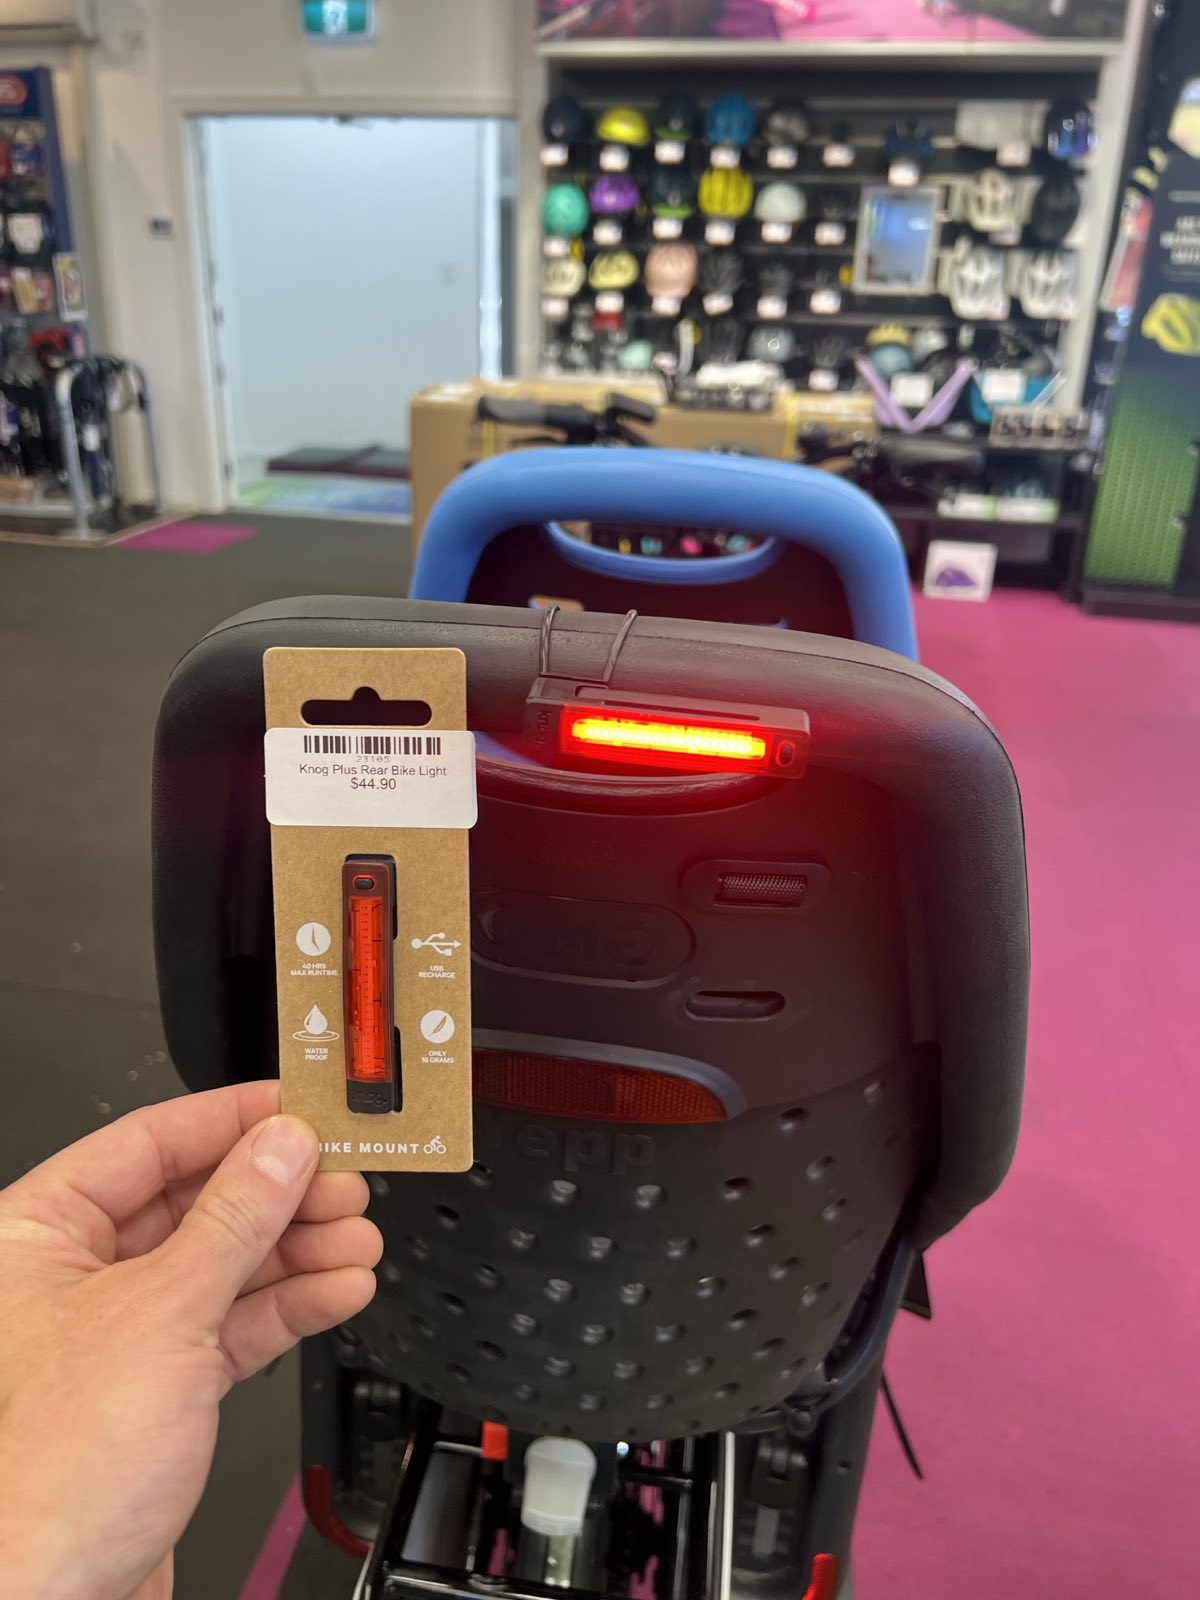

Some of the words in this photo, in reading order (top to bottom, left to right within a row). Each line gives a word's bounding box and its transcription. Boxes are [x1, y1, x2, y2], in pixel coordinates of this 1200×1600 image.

[356, 755, 391, 763] 23105
[299, 764, 329, 776] Knog
[333, 765, 358, 775] Plus
[361, 766, 389, 776] Rear
[392, 766, 416, 776] Bike
[419, 767, 447, 778] Light
[350, 778, 397, 790] $44.90
[418, 971, 456, 979] RECHARGE
[429, 1056, 455, 1064] GRAMS
[359, 1143, 421, 1154] MOUNT
